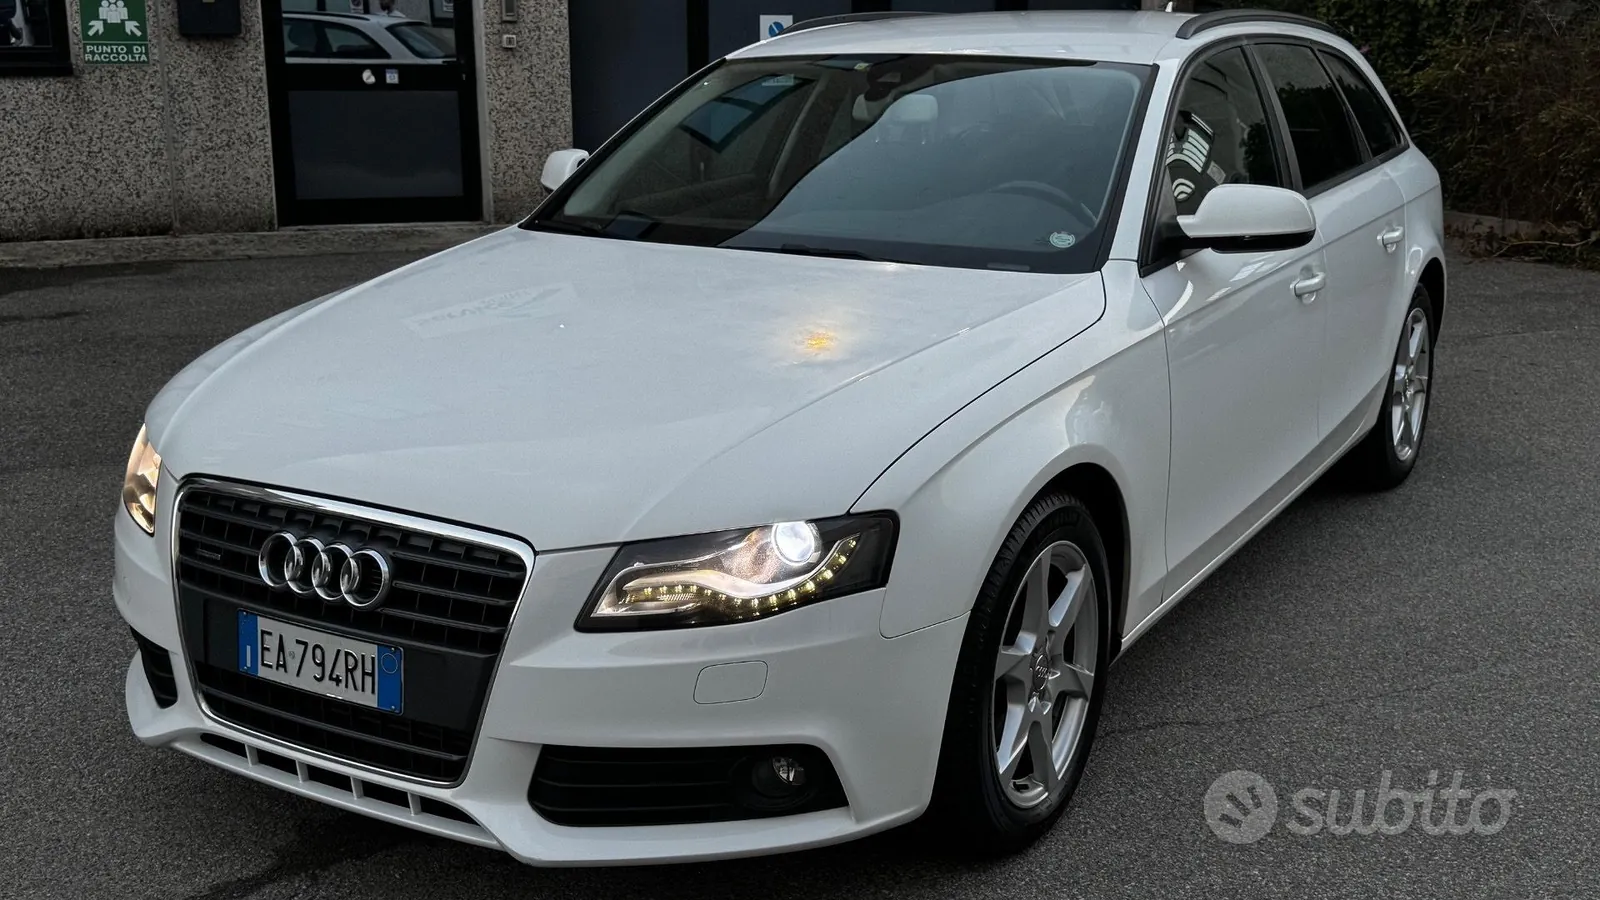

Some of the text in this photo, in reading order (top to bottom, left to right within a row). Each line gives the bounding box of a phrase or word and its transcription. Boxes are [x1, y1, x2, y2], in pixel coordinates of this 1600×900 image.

[86, 45, 146, 53] PUNTO DI
[84, 54, 148, 62] RACCOLTA
